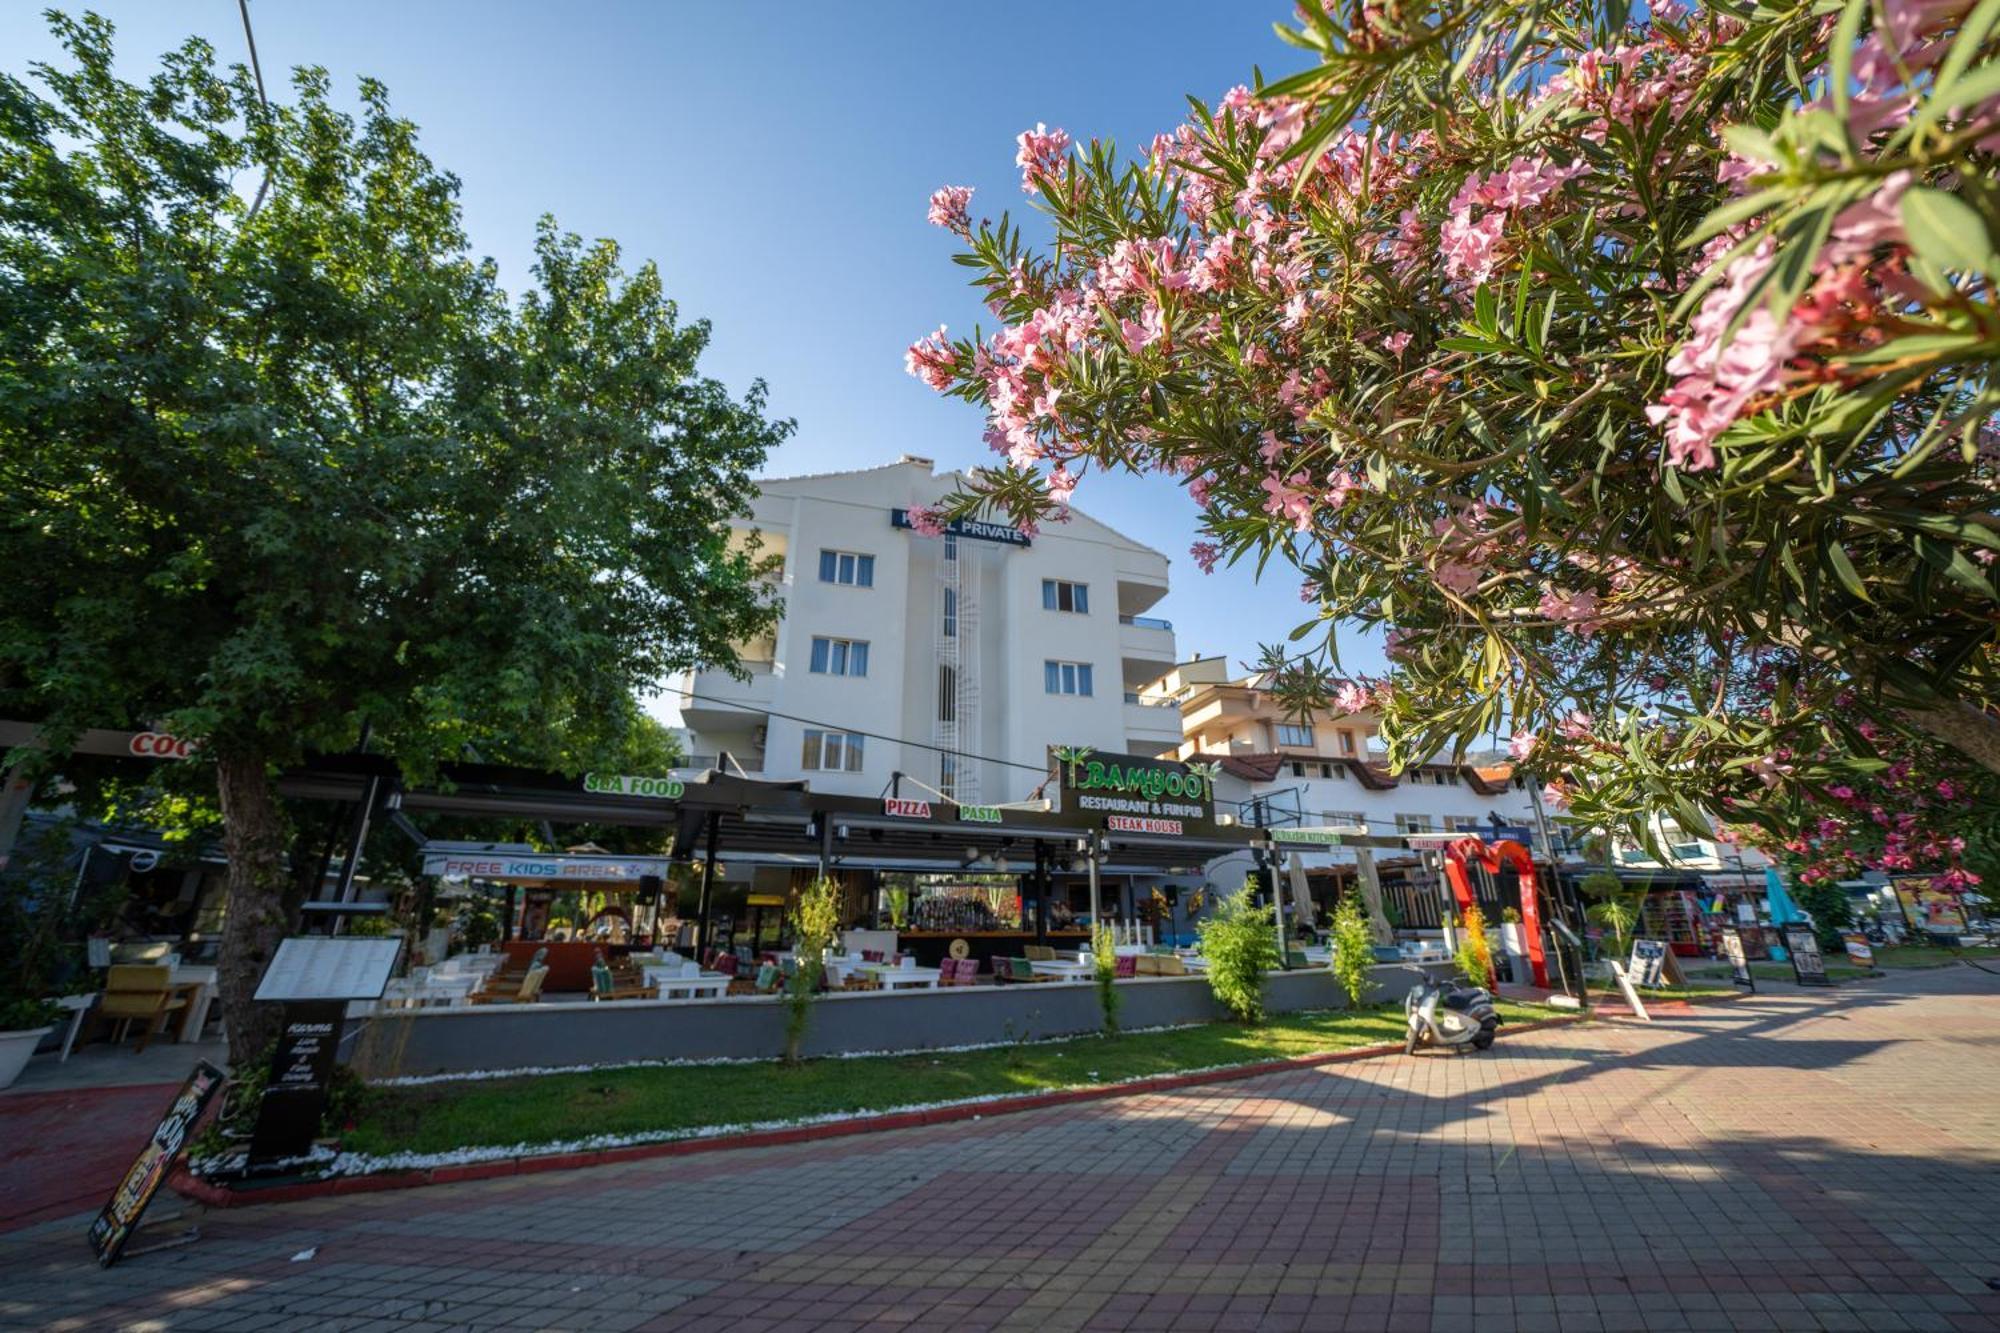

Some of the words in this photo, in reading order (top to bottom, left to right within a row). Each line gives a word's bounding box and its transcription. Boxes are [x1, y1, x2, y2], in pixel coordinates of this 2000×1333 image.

[962, 522, 1023, 541] PRIVATE
[630, 777, 684, 798] FOOD
[1077, 761, 1201, 800] BAMBOO
[886, 797, 931, 817] PIZZA
[960, 804, 1001, 822] PASTA
[1079, 796, 1149, 814] RESTAURANT
[1152, 802, 1161, 814] &
[1108, 815, 1142, 831] STEAK
[1145, 818, 1183, 834] HOUSE
[444, 861, 502, 874] FREE
[508, 863, 557, 876] KIDS
